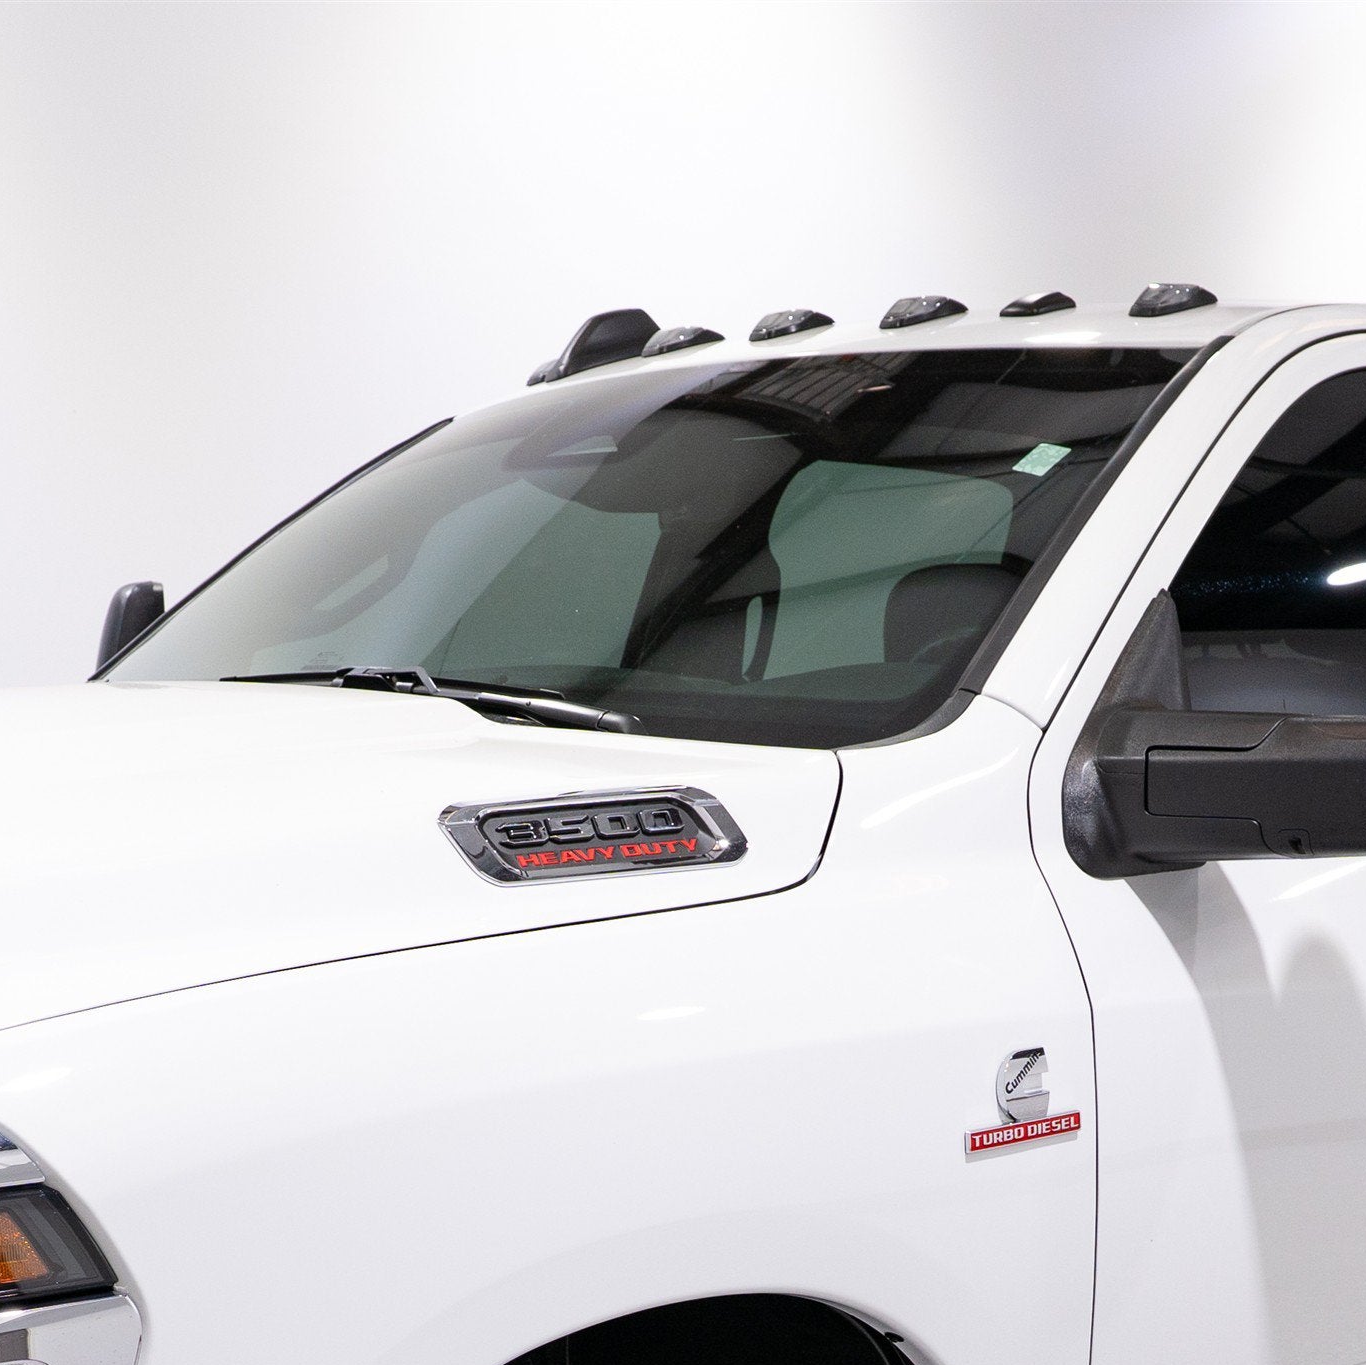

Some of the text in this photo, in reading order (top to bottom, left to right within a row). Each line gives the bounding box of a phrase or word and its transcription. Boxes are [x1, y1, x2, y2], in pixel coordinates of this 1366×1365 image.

[497, 808, 686, 847] 3500
[516, 838, 698, 868] HEAVY DUTY
[972, 1116, 1080, 1148] TURBO DIESEL
